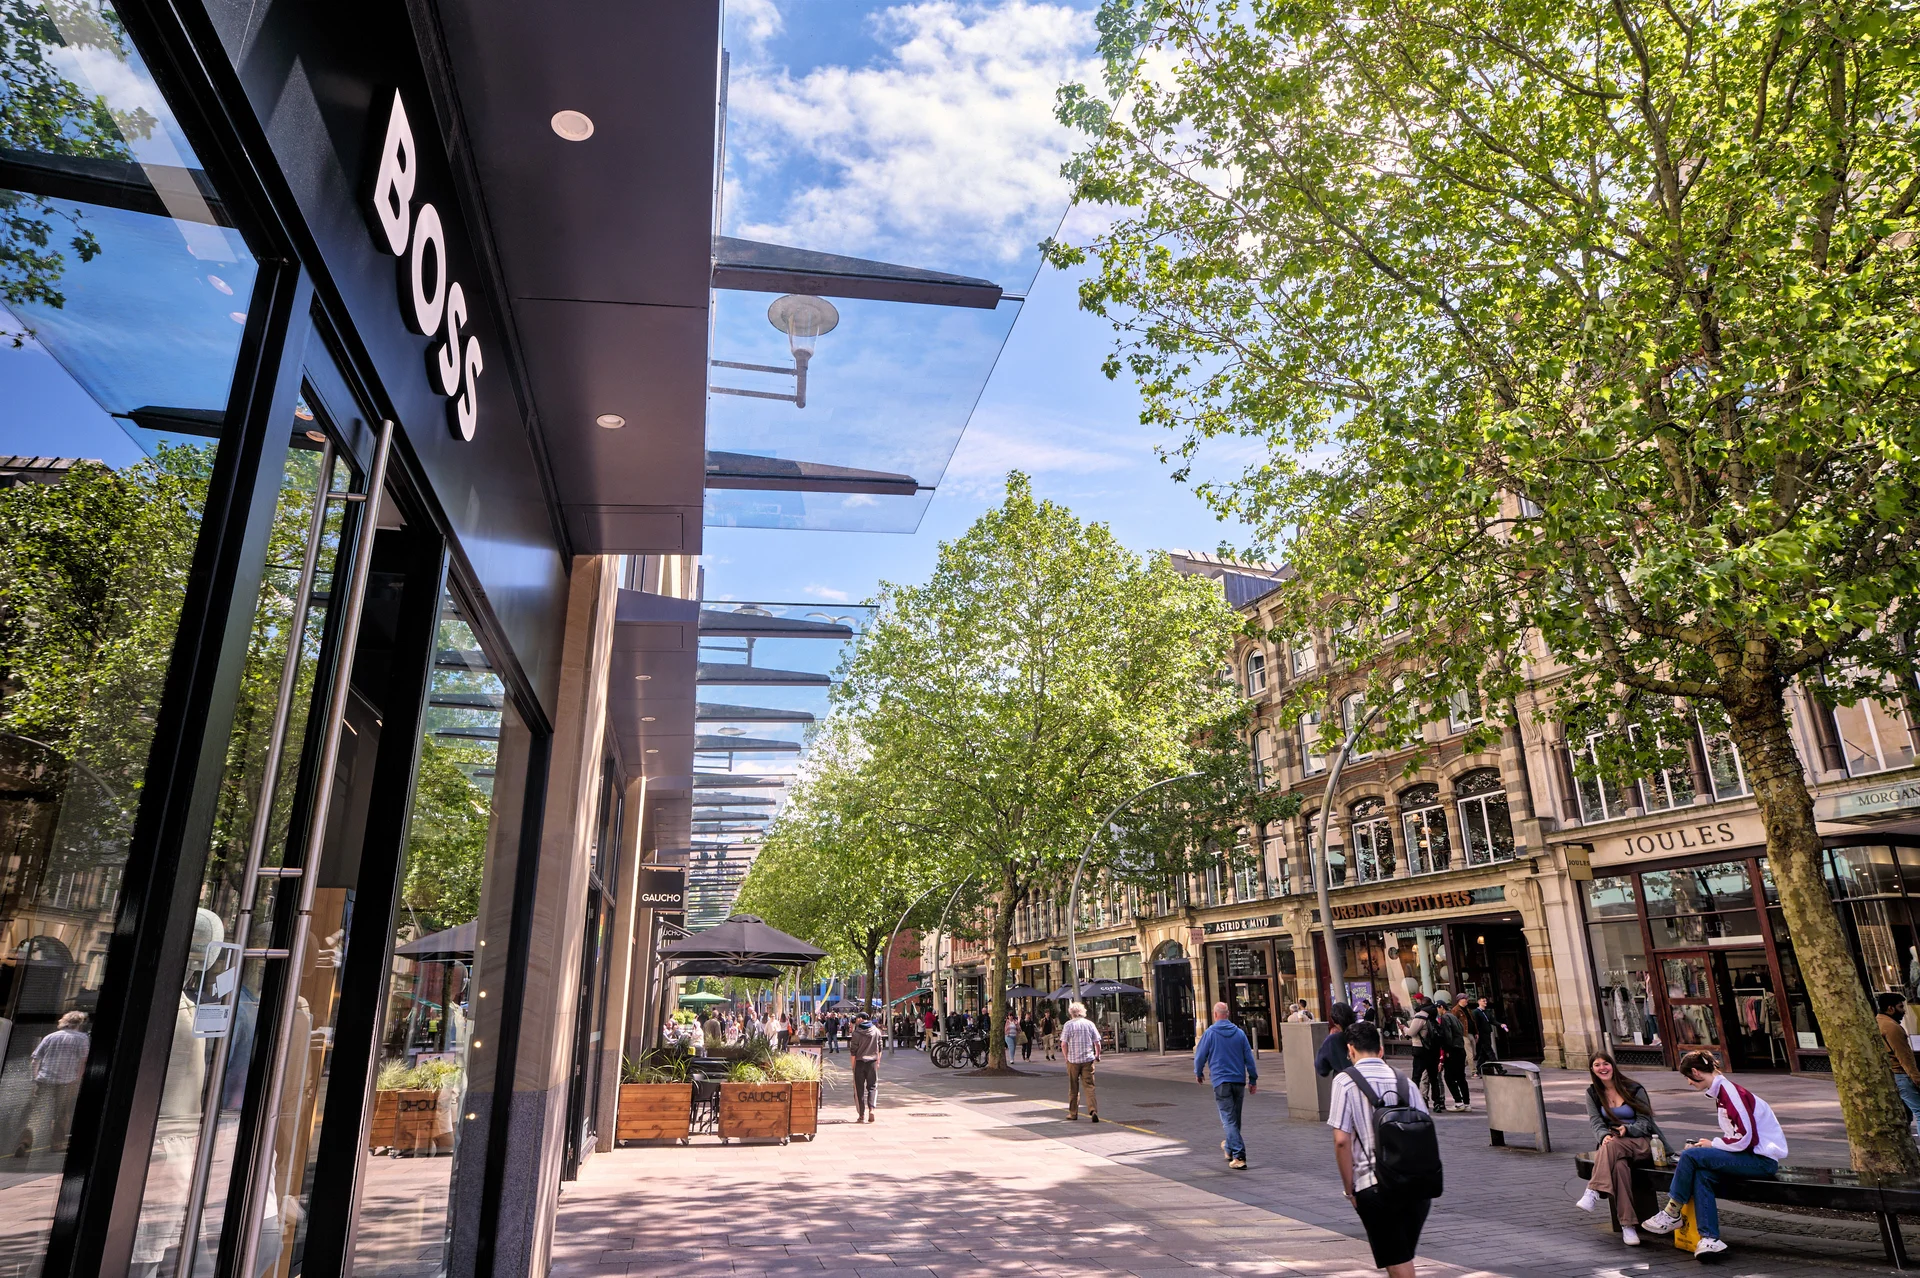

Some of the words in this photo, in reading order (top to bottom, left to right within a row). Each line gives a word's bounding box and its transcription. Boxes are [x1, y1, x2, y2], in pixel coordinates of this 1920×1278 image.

[374, 87, 483, 441] BOSS
[1624, 823, 1735, 856] JOULES
[642, 893, 681, 902] GAUCHO
[1331, 902, 1376, 920] URBAN
[1379, 890, 1472, 914] OUTFITTERS
[1216, 922, 1240, 932] ASTRID
[1241, 920, 1247, 929] &
[1249, 918, 1269, 928] MIYU
[738, 1091, 788, 1102] GAUCHO
